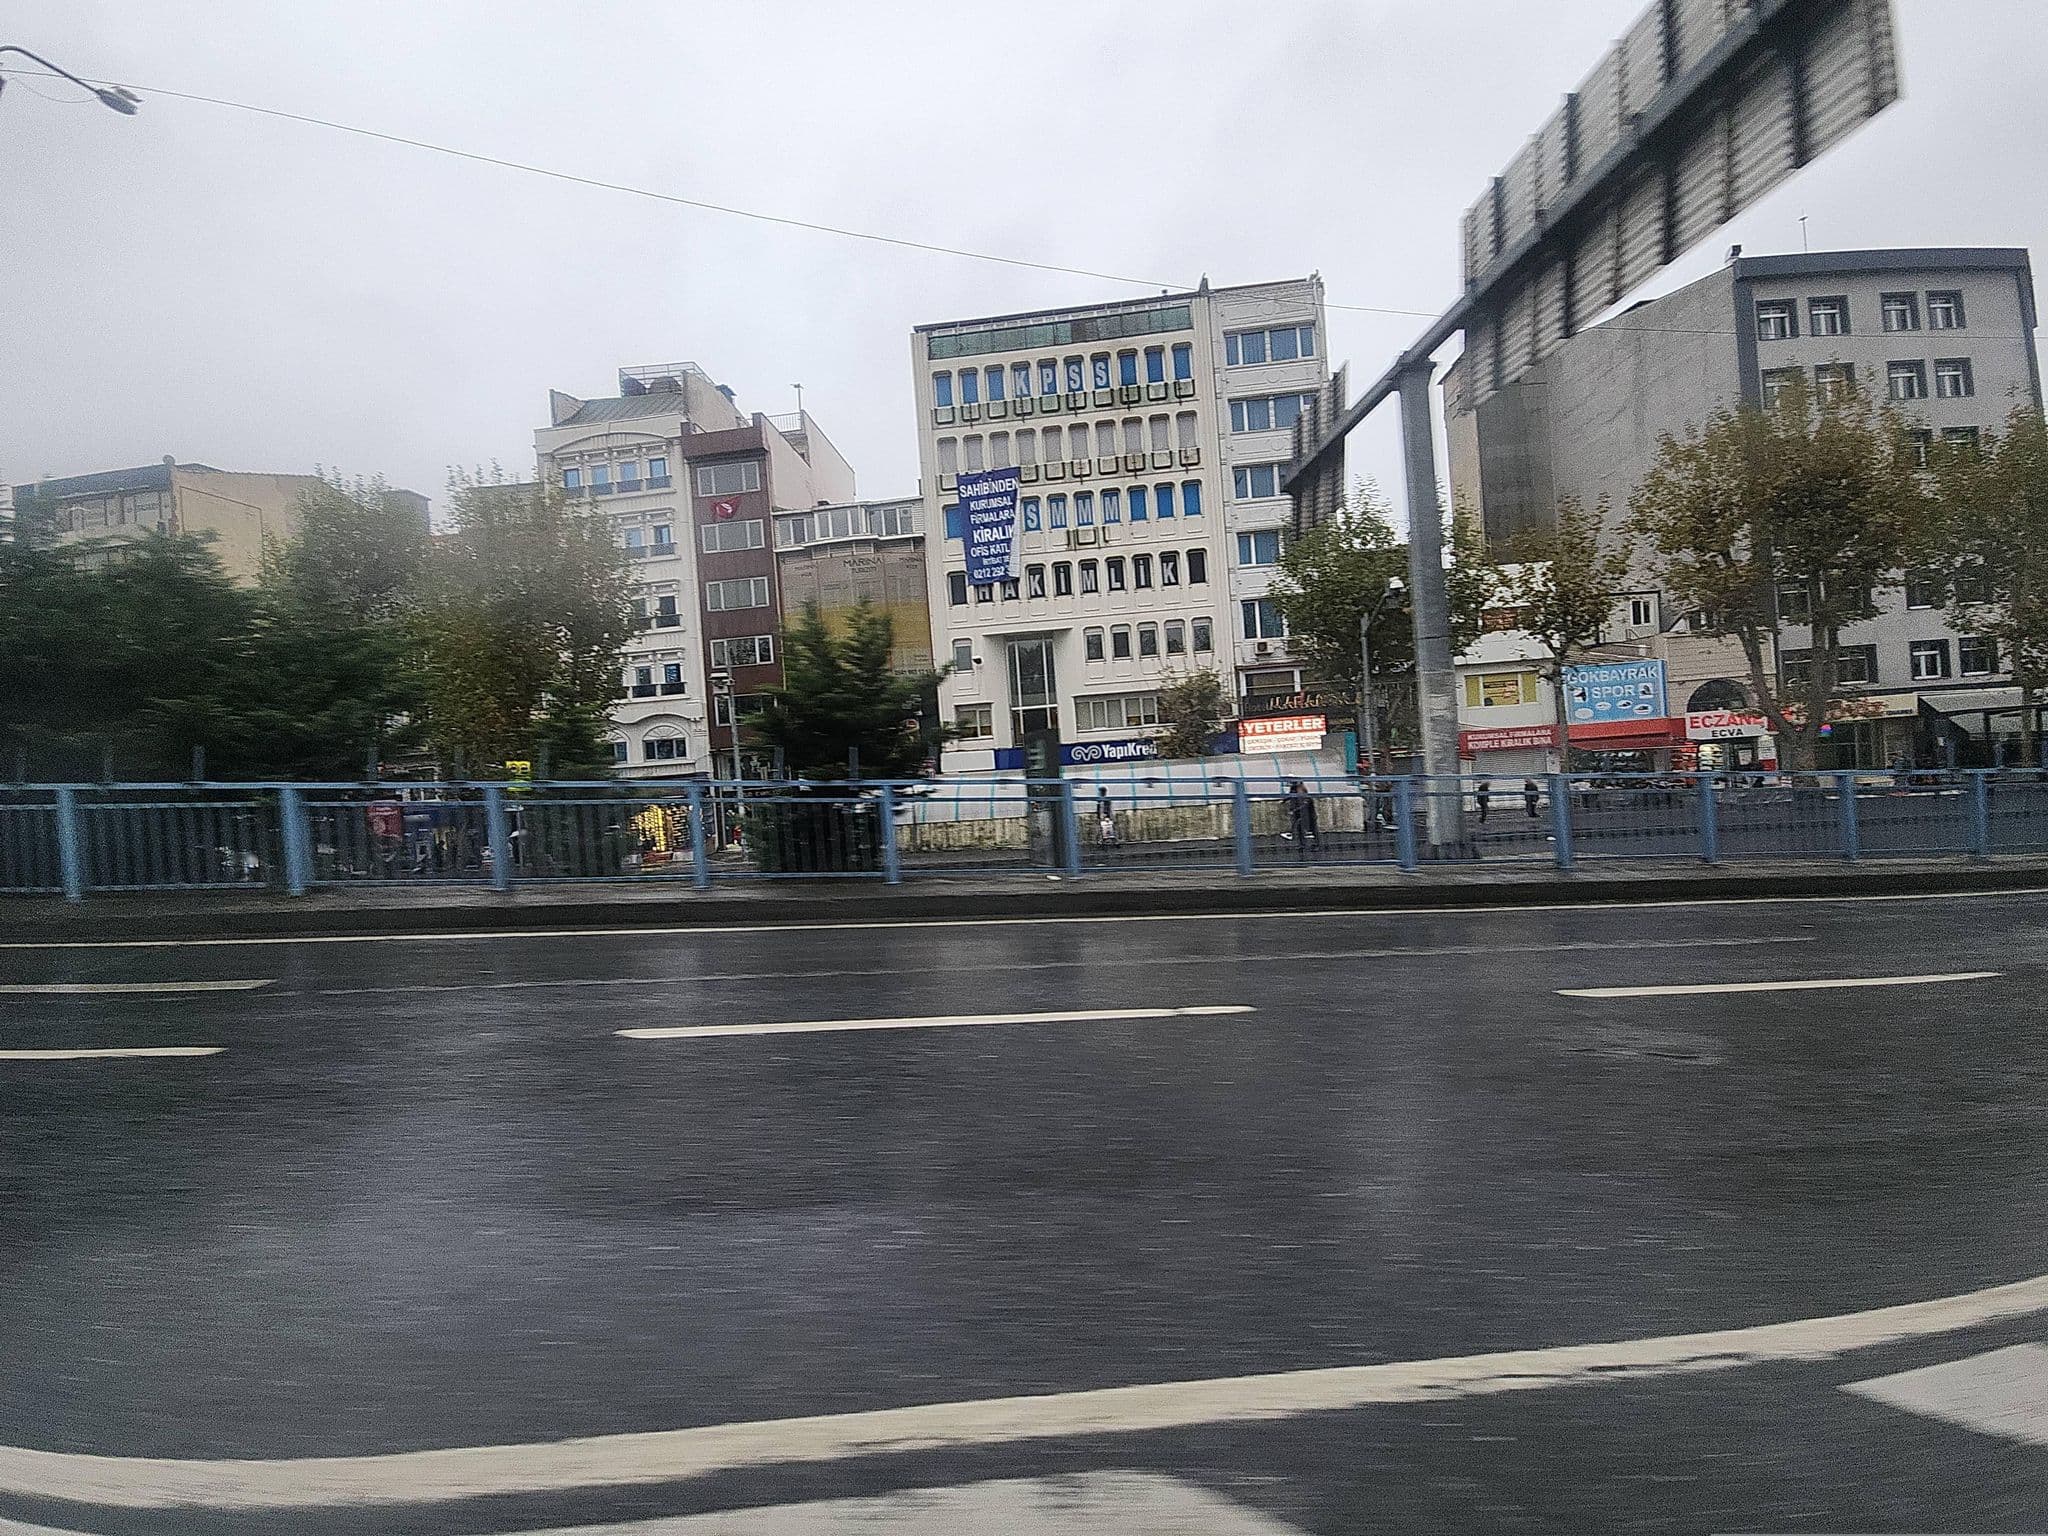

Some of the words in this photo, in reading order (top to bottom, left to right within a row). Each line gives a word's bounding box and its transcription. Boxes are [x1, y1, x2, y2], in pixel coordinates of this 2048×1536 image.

[1015, 361, 1107, 395] KPSS
[959, 476, 1018, 498] SAHİBİNDEN
[969, 495, 1013, 511] KURUMSAL
[1027, 496, 1121, 529] SMMM
[1592, 684, 1636, 699] SPOR
[1243, 718, 1324, 734] YETERLER
[1711, 727, 1744, 738] ECVA
